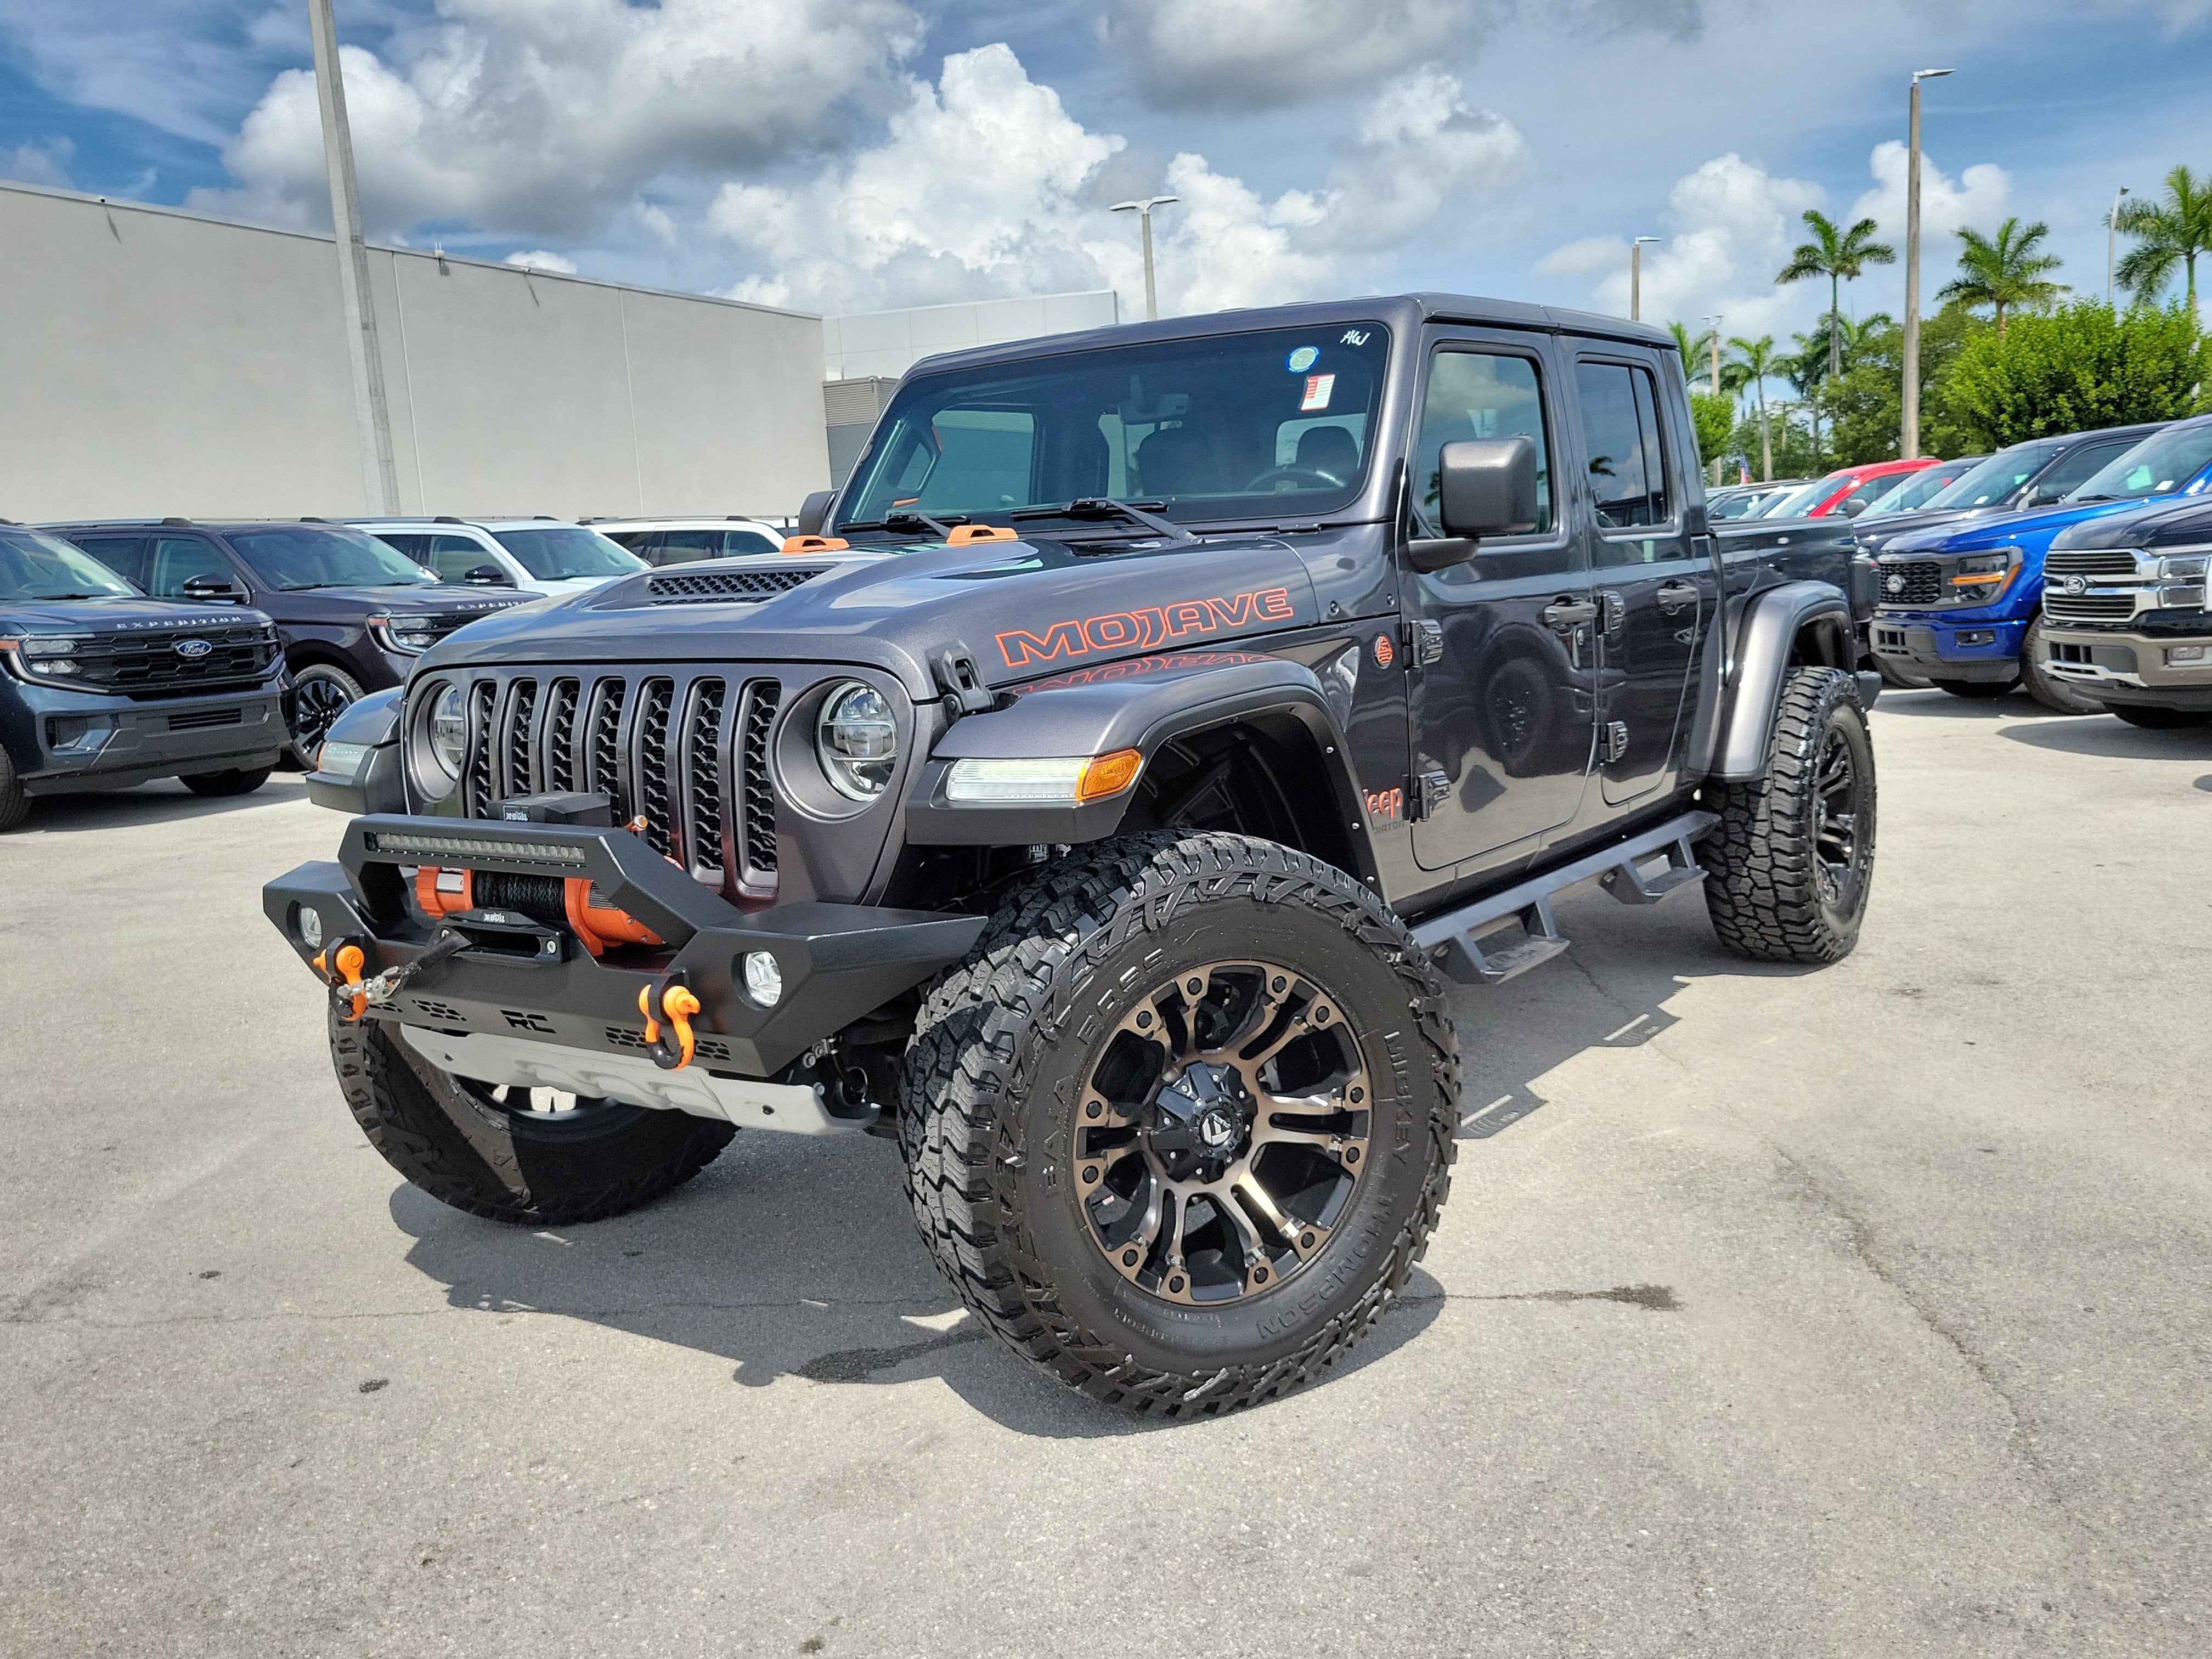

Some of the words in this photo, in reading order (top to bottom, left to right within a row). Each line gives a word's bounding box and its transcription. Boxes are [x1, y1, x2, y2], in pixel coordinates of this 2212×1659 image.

[116, 616, 242, 629] EXPEDITION
[995, 587, 1294, 667] MOJAVE
[483, 912, 506, 923] X-BULL
[500, 1009, 557, 1034] RC
[1384, 1030, 1413, 1165] MICKEY
[1255, 1193, 1392, 1340] THOMPSON
